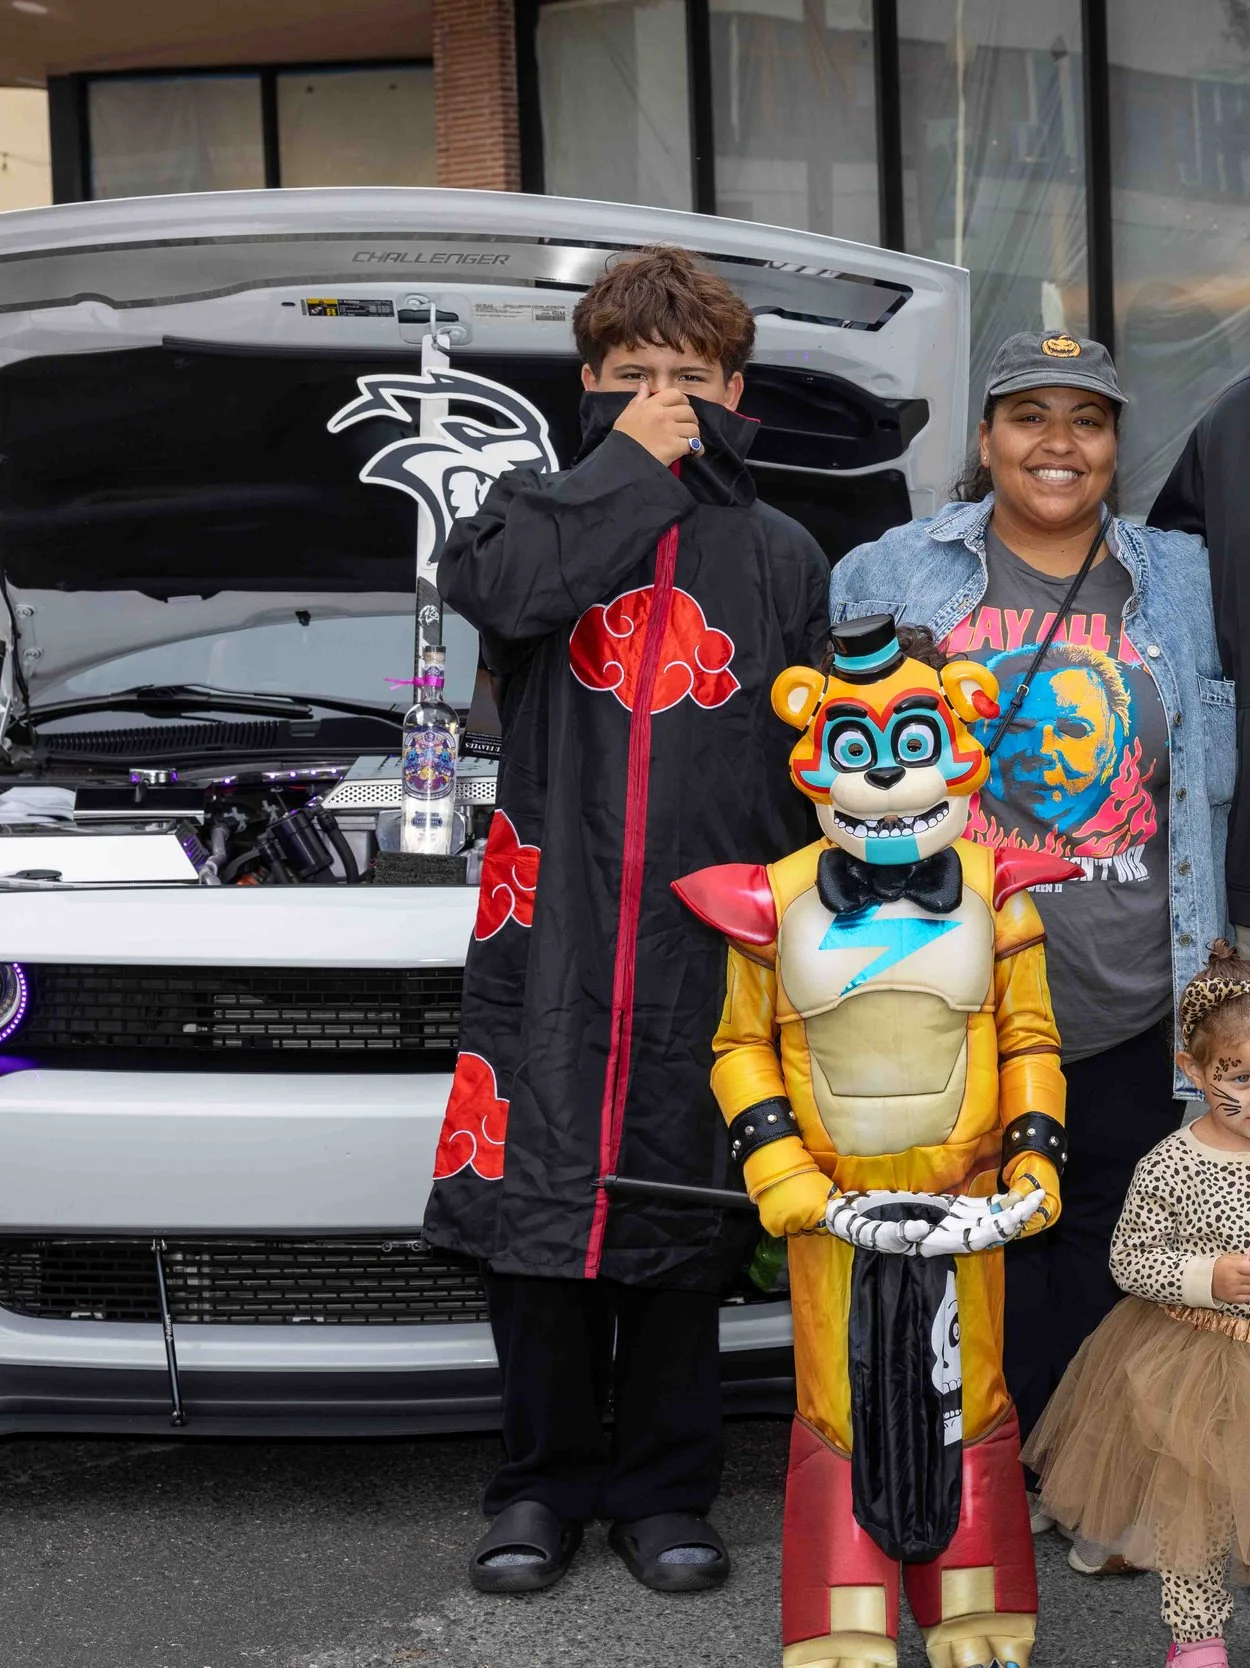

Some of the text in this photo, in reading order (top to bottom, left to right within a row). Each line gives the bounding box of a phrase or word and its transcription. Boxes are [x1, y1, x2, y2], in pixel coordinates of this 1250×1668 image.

[352, 250, 510, 265] CHALLENGER
[936, 605, 1034, 657] LAY
[1036, 612, 1110, 653] ALL
[1054, 884, 1063, 893] II
